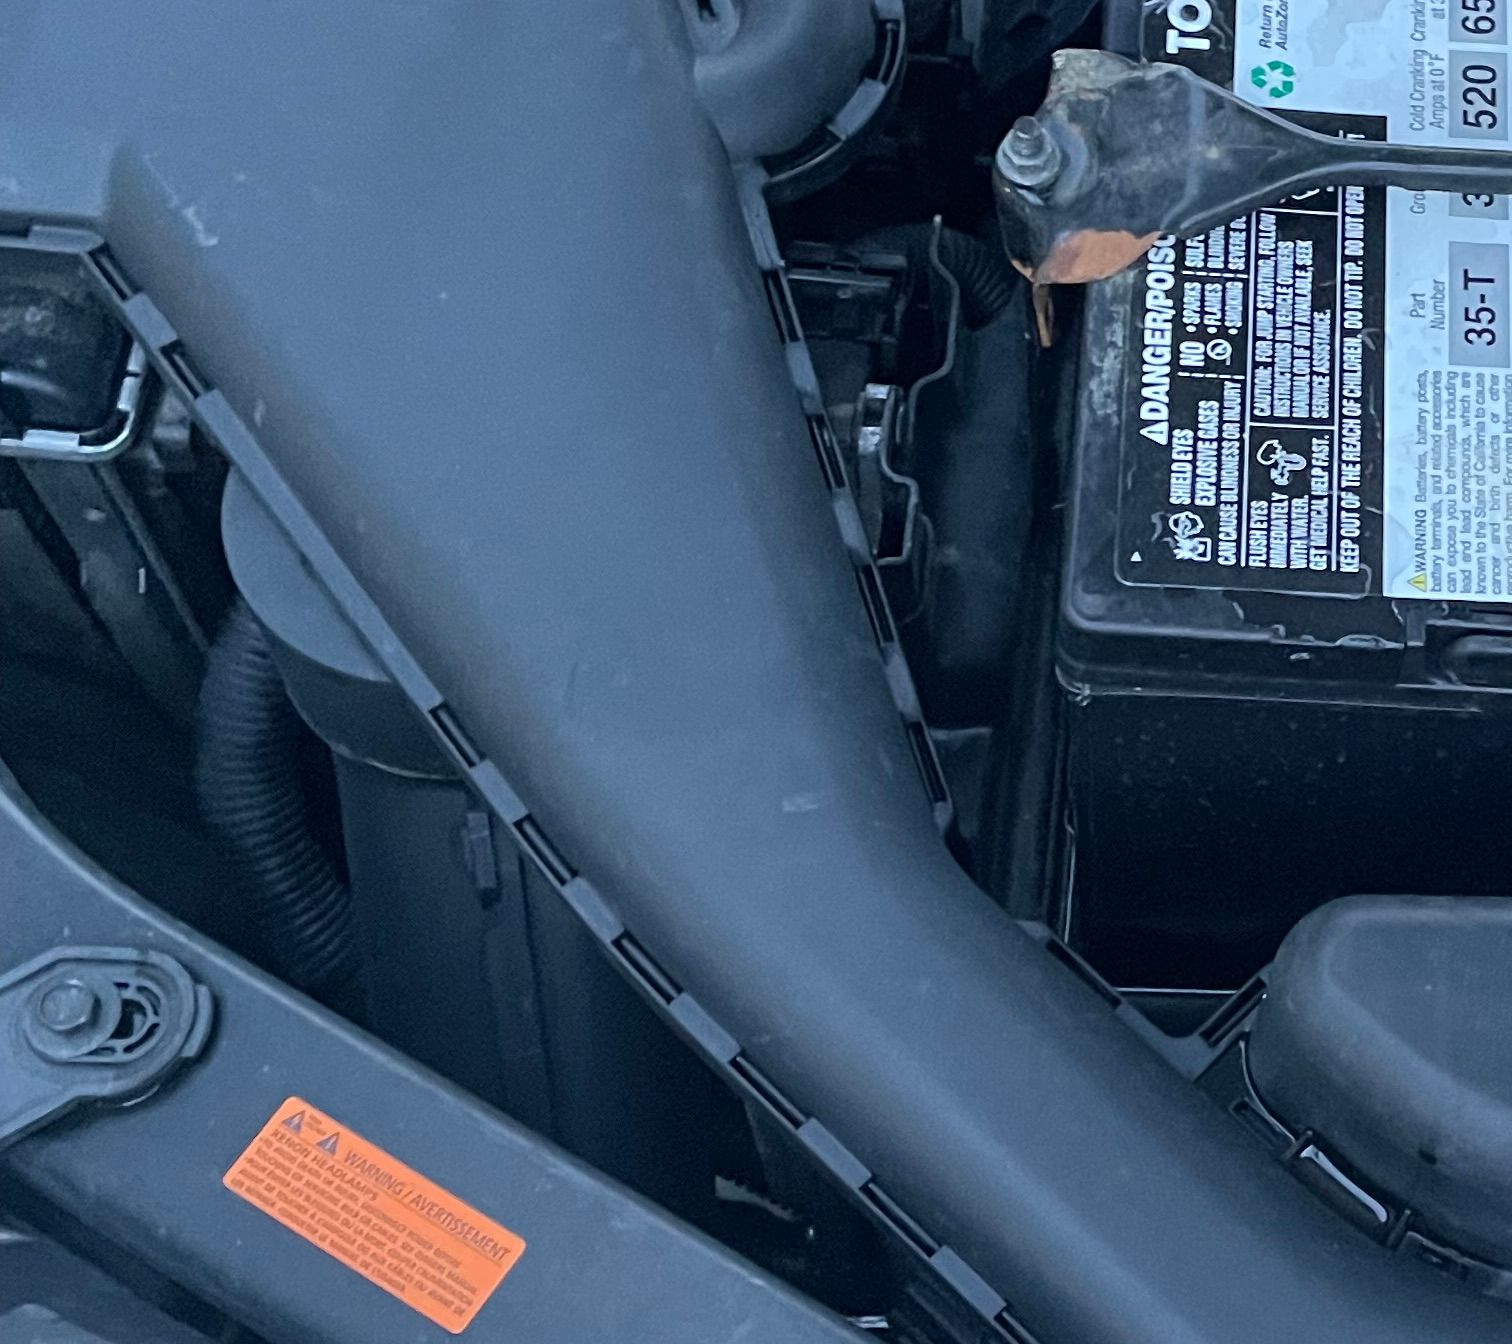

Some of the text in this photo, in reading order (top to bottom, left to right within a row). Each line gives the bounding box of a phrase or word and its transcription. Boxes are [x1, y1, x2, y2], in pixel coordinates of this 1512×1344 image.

[1258, 4, 1272, 48] Return
[1430, 7, 1445, 19] at
[1408, 48, 1428, 131] Cold Cranking
[1430, 79, 1445, 91] at
[1462, 64, 1497, 128] 520
[1428, 94, 1447, 129] Amps
[1409, 193, 1426, 214] Gro
[1462, 193, 1495, 207] 3
[1258, 213, 1276, 254] FOLLOW
[1344, 215, 1364, 238] NOT
[1227, 230, 1246, 269] SEVERE
[1277, 240, 1294, 284] OWNERS
[1295, 239, 1313, 265] SEEK
[1344, 239, 1364, 255] DO
[1343, 260, 1363, 281] TIP.
[1182, 281, 1201, 324] SPARKS
[1203, 283, 1222, 325] FLAMES
[1276, 285, 1292, 327] VEHICLE
[1343, 283, 1363, 308] NOT
[1409, 292, 1426, 317] Part
[1429, 278, 1446, 330] Number
[1463, 268, 1496, 345] 35-T
[1140, 235, 1176, 420] DANGER/POISO
[1256, 309, 1273, 339] JUMP
[1275, 328, 1292, 341] IN
[1294, 323, 1312, 346] NOT
[1343, 310, 1363, 328] DO
[1178, 340, 1205, 365] NO
[1254, 340, 1273, 362] FOR
[1294, 346, 1311, 357] IF
[1294, 358, 1310, 374] OR
[1222, 380, 1241, 420] INJURY
[1293, 374, 1309, 417] MANUAL
[1311, 374, 1330, 418] SERVICE
[1342, 398, 1362, 415] OF
[1222, 422, 1240, 439] OR
[1341, 418, 1361, 460] REACH
[1169, 428, 1194, 504] SHIELD EYES
[1194, 400, 1219, 506] EXPLOSIVE GASES
[1341, 462, 1361, 487] THE
[1308, 434, 1331, 570] GET MEDICAL HELP FAST.
[1340, 490, 1360, 508] OF
[1218, 503, 1238, 540] CAUSE
[1248, 500, 1268, 566] FLUSH EYES
[1269, 491, 1289, 568] IMMEDIATELY
[1340, 510, 1361, 536] OUT
[1217, 540, 1237, 565] CAN
[1289, 538, 1308, 568] WITH
[1340, 538, 1361, 572] KEEP
[343, 1151, 406, 1194] WARNING
[409, 1192, 512, 1263] AVERTISSEMENT
